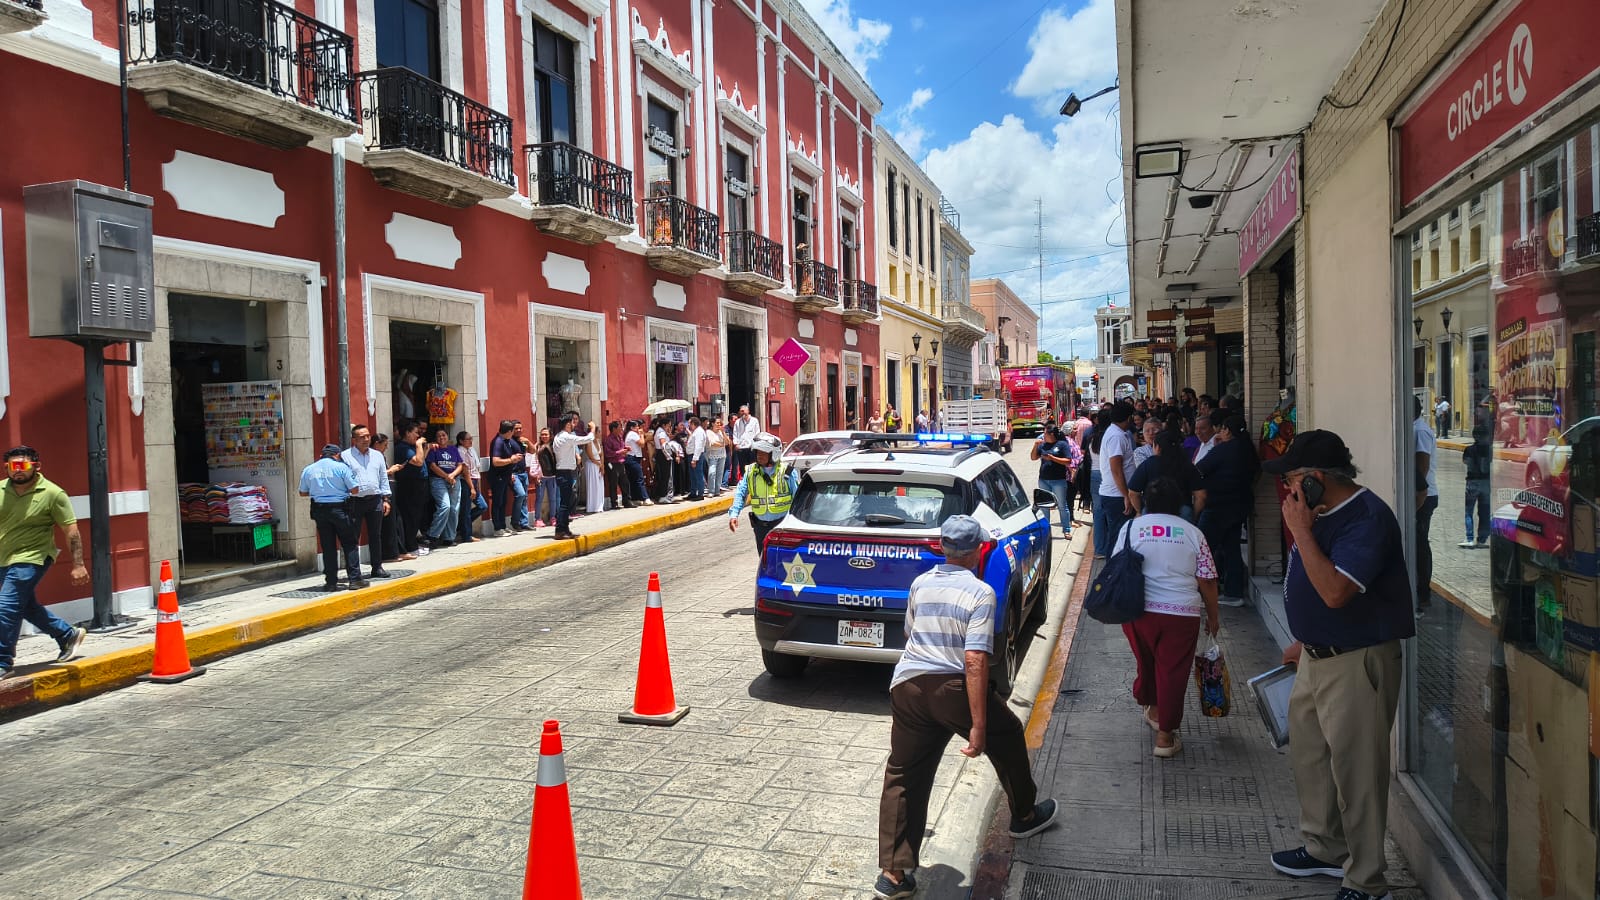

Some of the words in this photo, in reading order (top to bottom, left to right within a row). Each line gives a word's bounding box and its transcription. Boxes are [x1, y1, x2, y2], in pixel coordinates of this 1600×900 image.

[1447, 59, 1502, 141] CIRCLE
[1507, 23, 1533, 105] K
[1239, 156, 1295, 258] SOUVENIRS
[1497, 325, 1554, 371] ETIQUETAS
[276, 360, 283, 370] 3
[1152, 525, 1184, 538] DIF
[856, 543, 922, 560] MUNICIPAL
[837, 593, 883, 607] ECO-011
